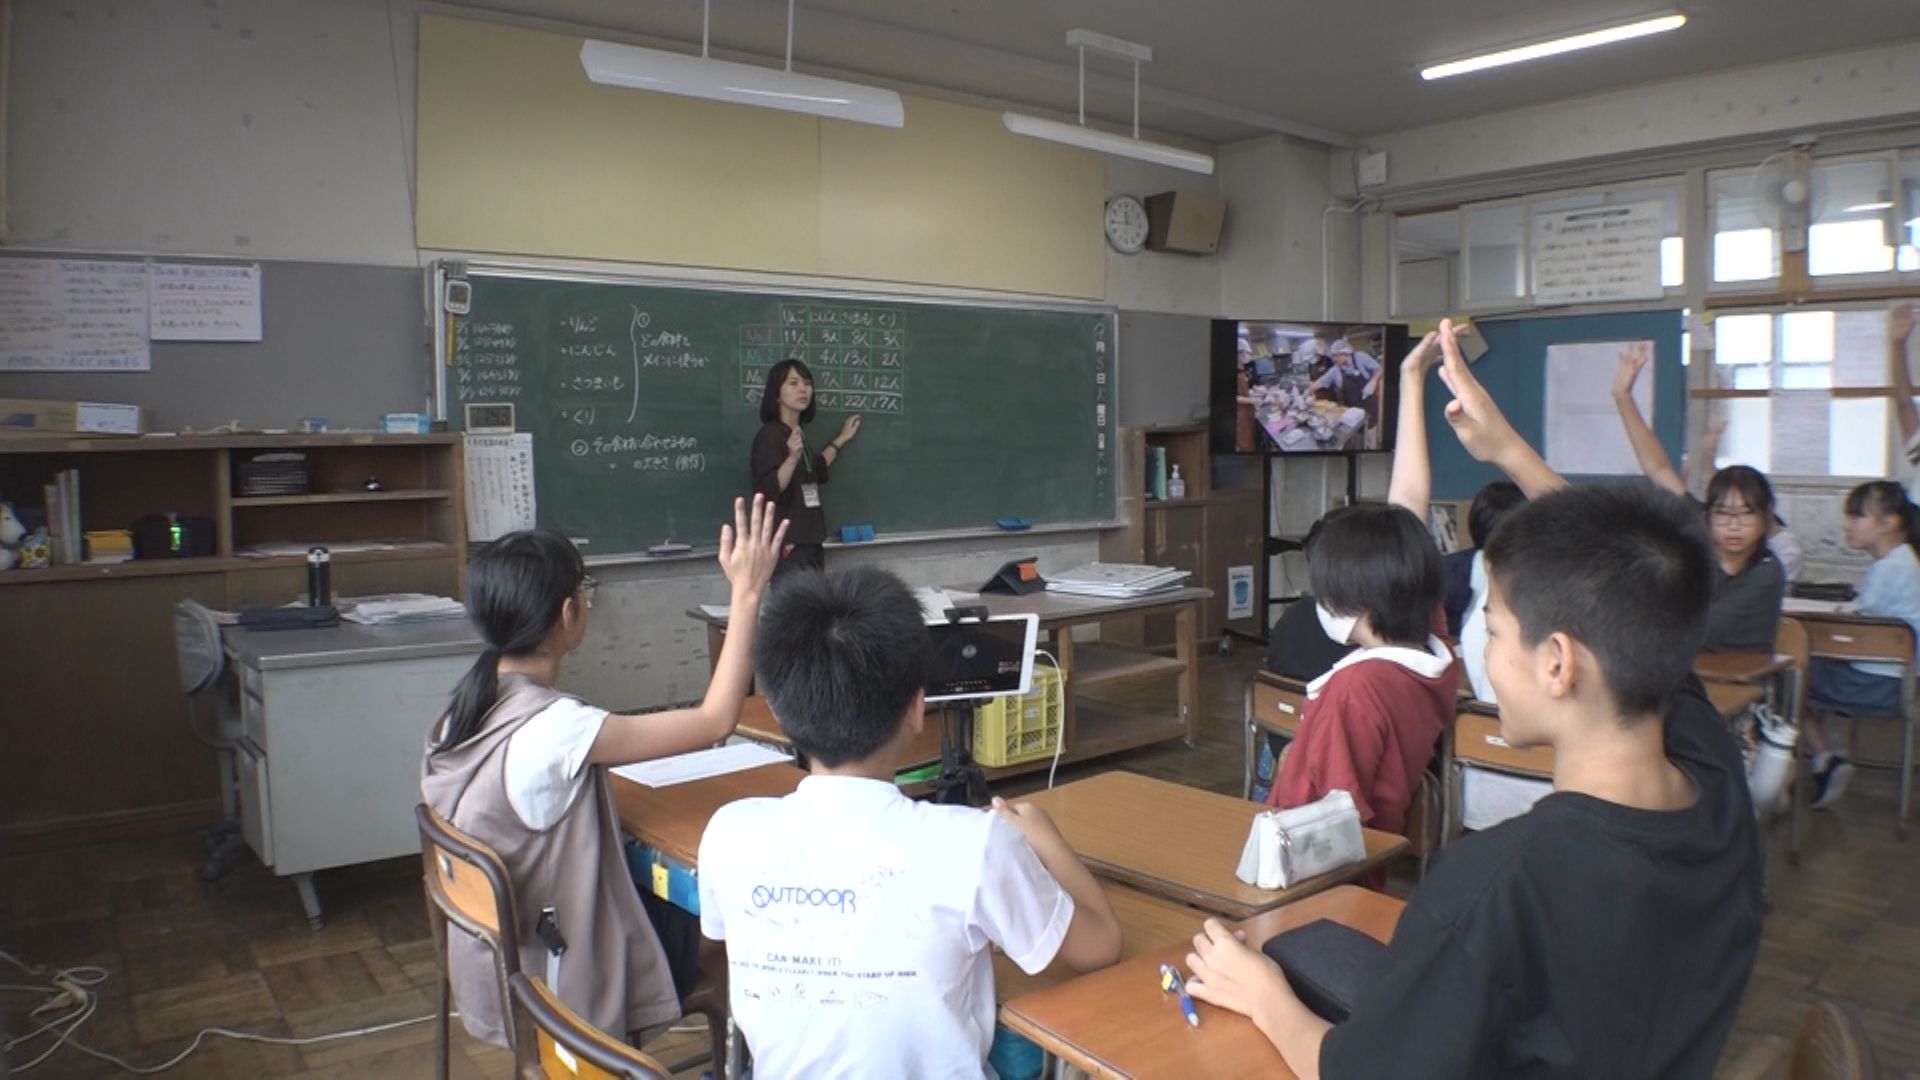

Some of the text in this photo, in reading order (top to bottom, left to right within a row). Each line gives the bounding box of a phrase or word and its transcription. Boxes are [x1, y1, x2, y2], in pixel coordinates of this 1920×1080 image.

[752, 885, 856, 914] OUTDOOR
[766, 953, 788, 963] CAN
[792, 955, 823, 966] MAKE
